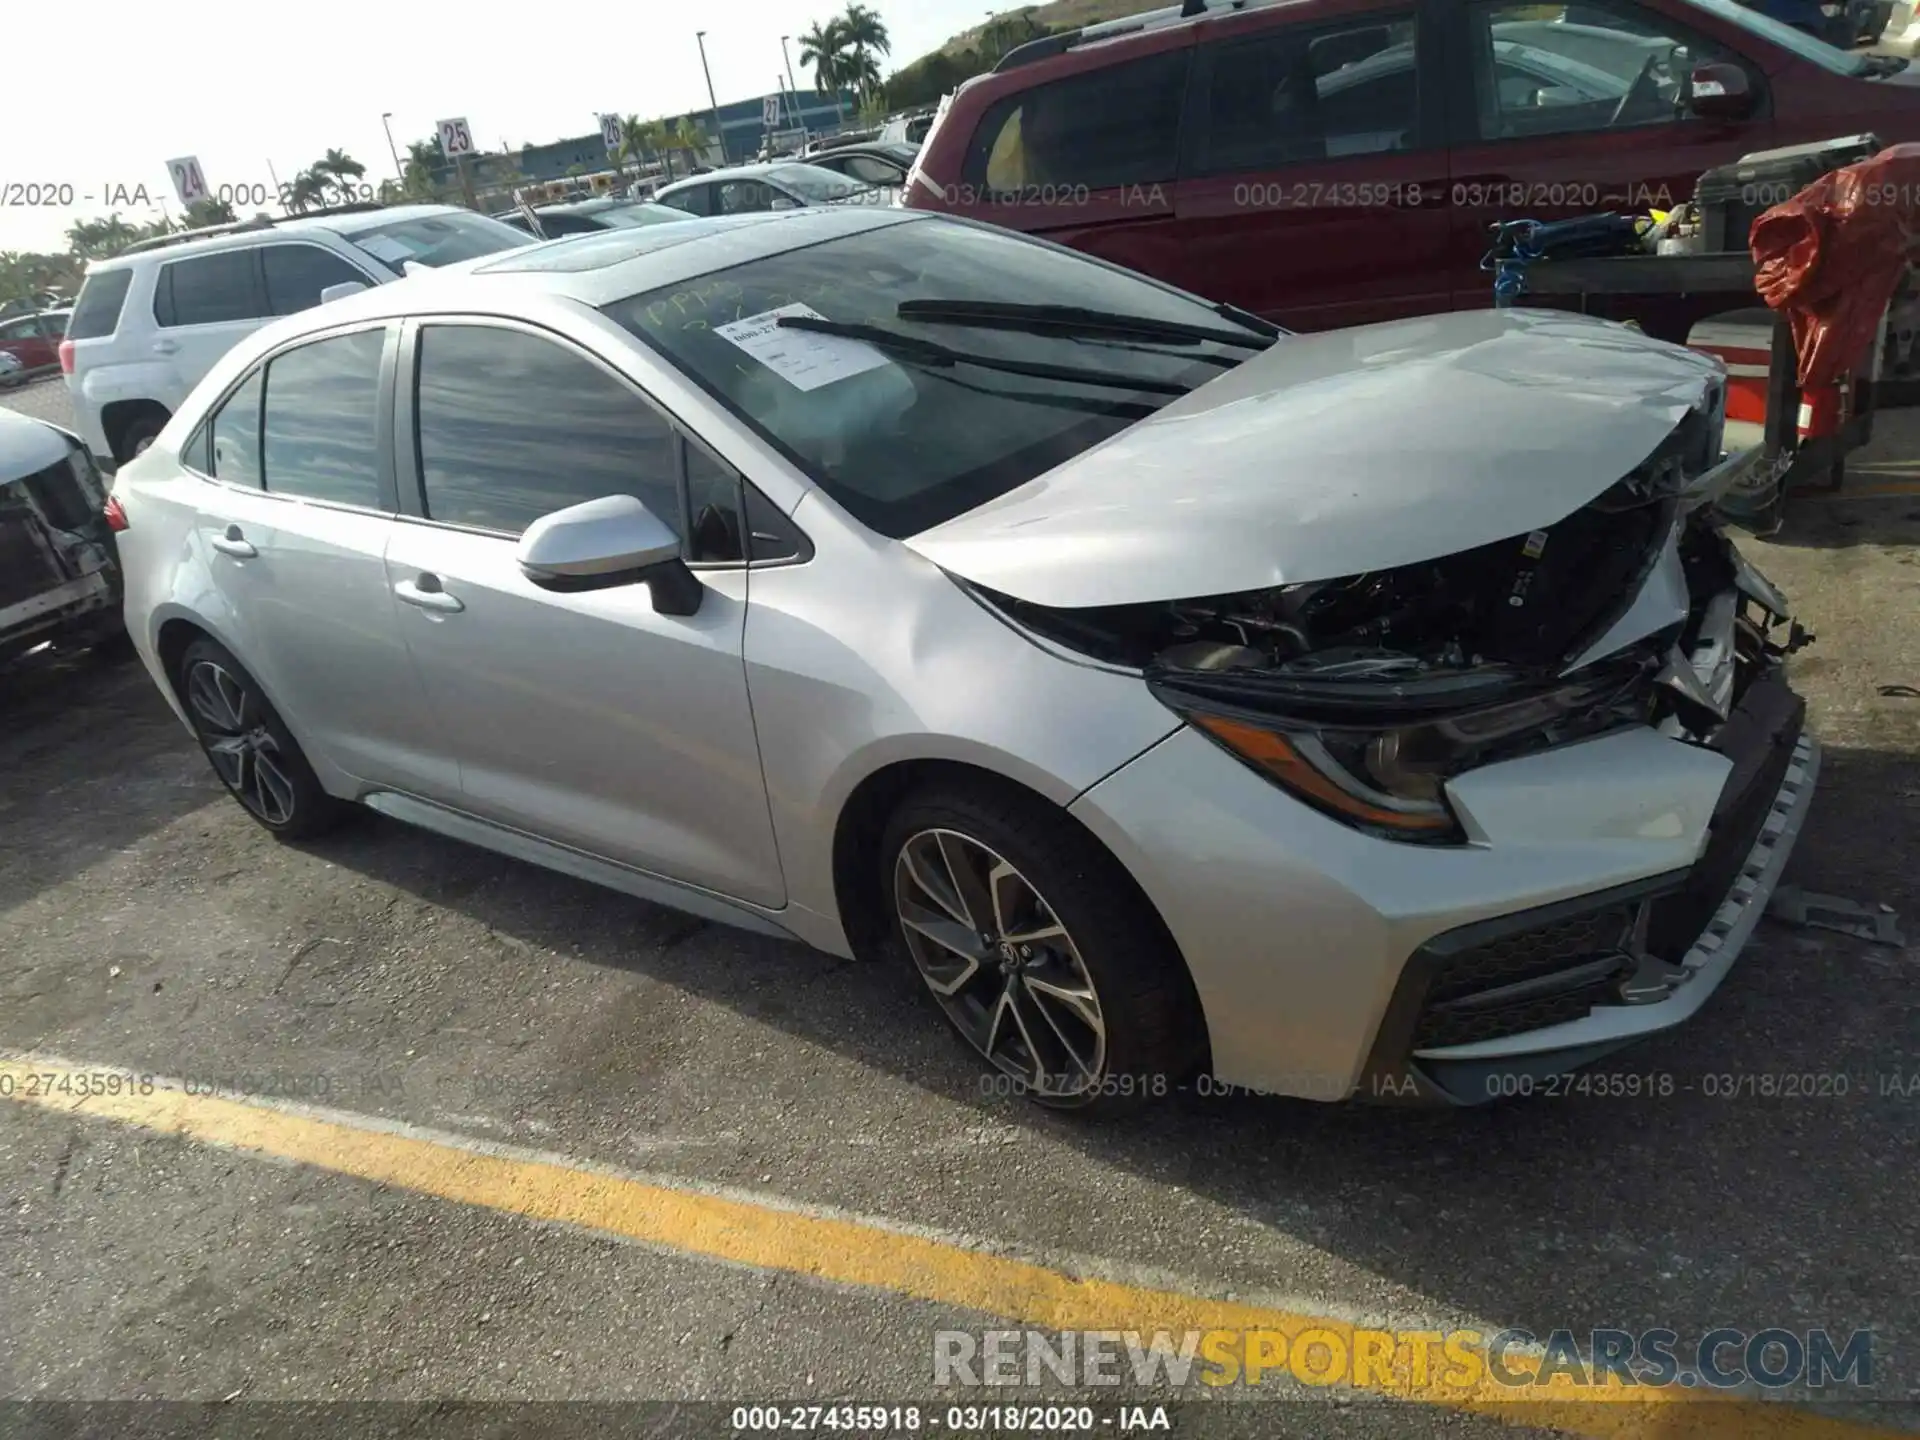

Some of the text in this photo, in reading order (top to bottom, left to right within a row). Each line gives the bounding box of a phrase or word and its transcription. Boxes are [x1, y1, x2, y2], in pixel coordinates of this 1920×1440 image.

[765, 98, 778, 122] 27
[443, 122, 470, 153] 25
[604, 116, 622, 145] 26
[174, 161, 205, 199] 24
